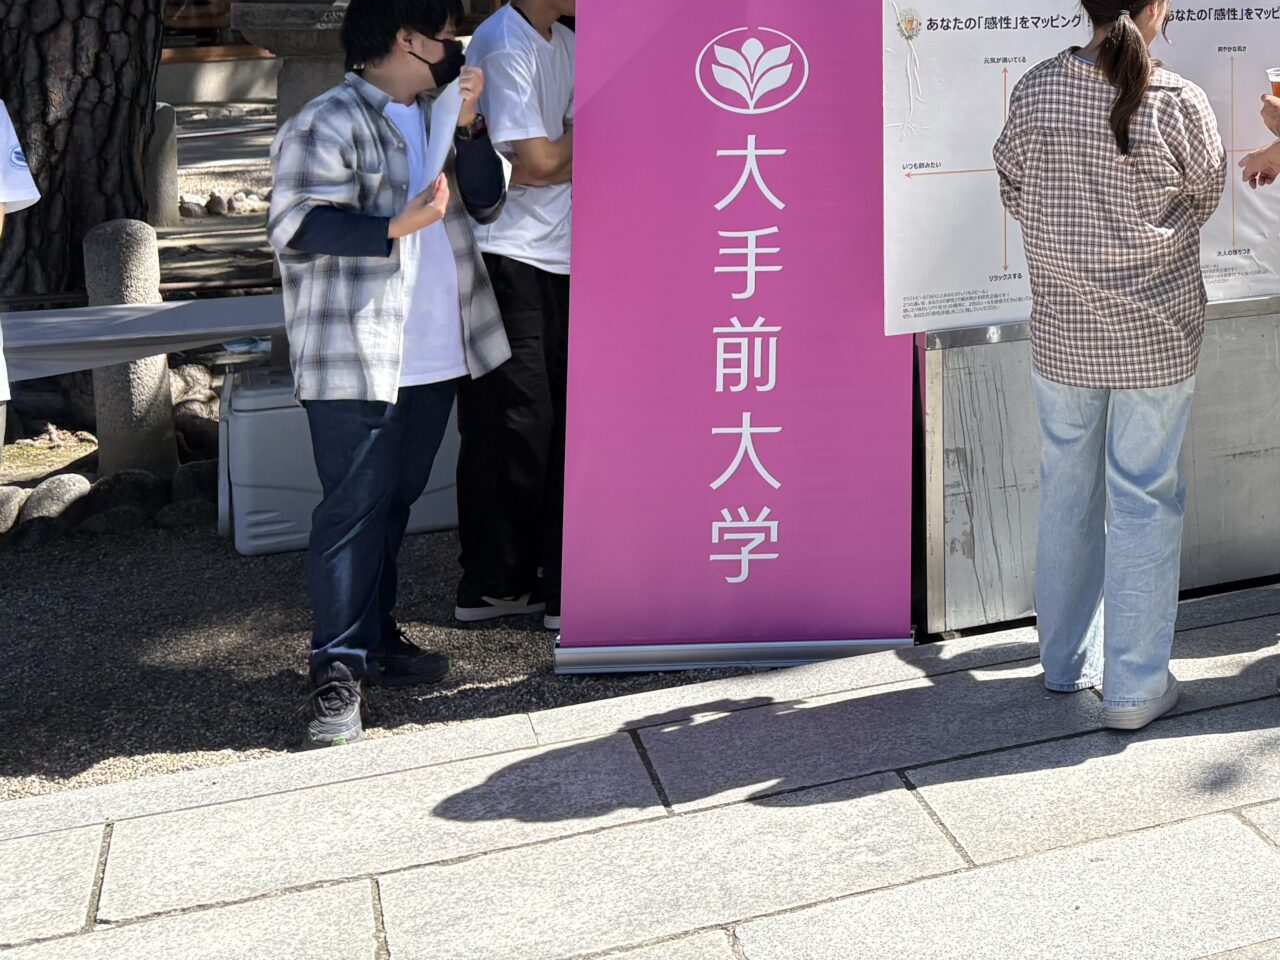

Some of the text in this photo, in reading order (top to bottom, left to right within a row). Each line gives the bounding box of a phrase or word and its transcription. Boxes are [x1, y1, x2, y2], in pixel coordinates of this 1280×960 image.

[709, 134, 787, 584] 大手前大学
[988, 272, 1023, 282] リラックスする
